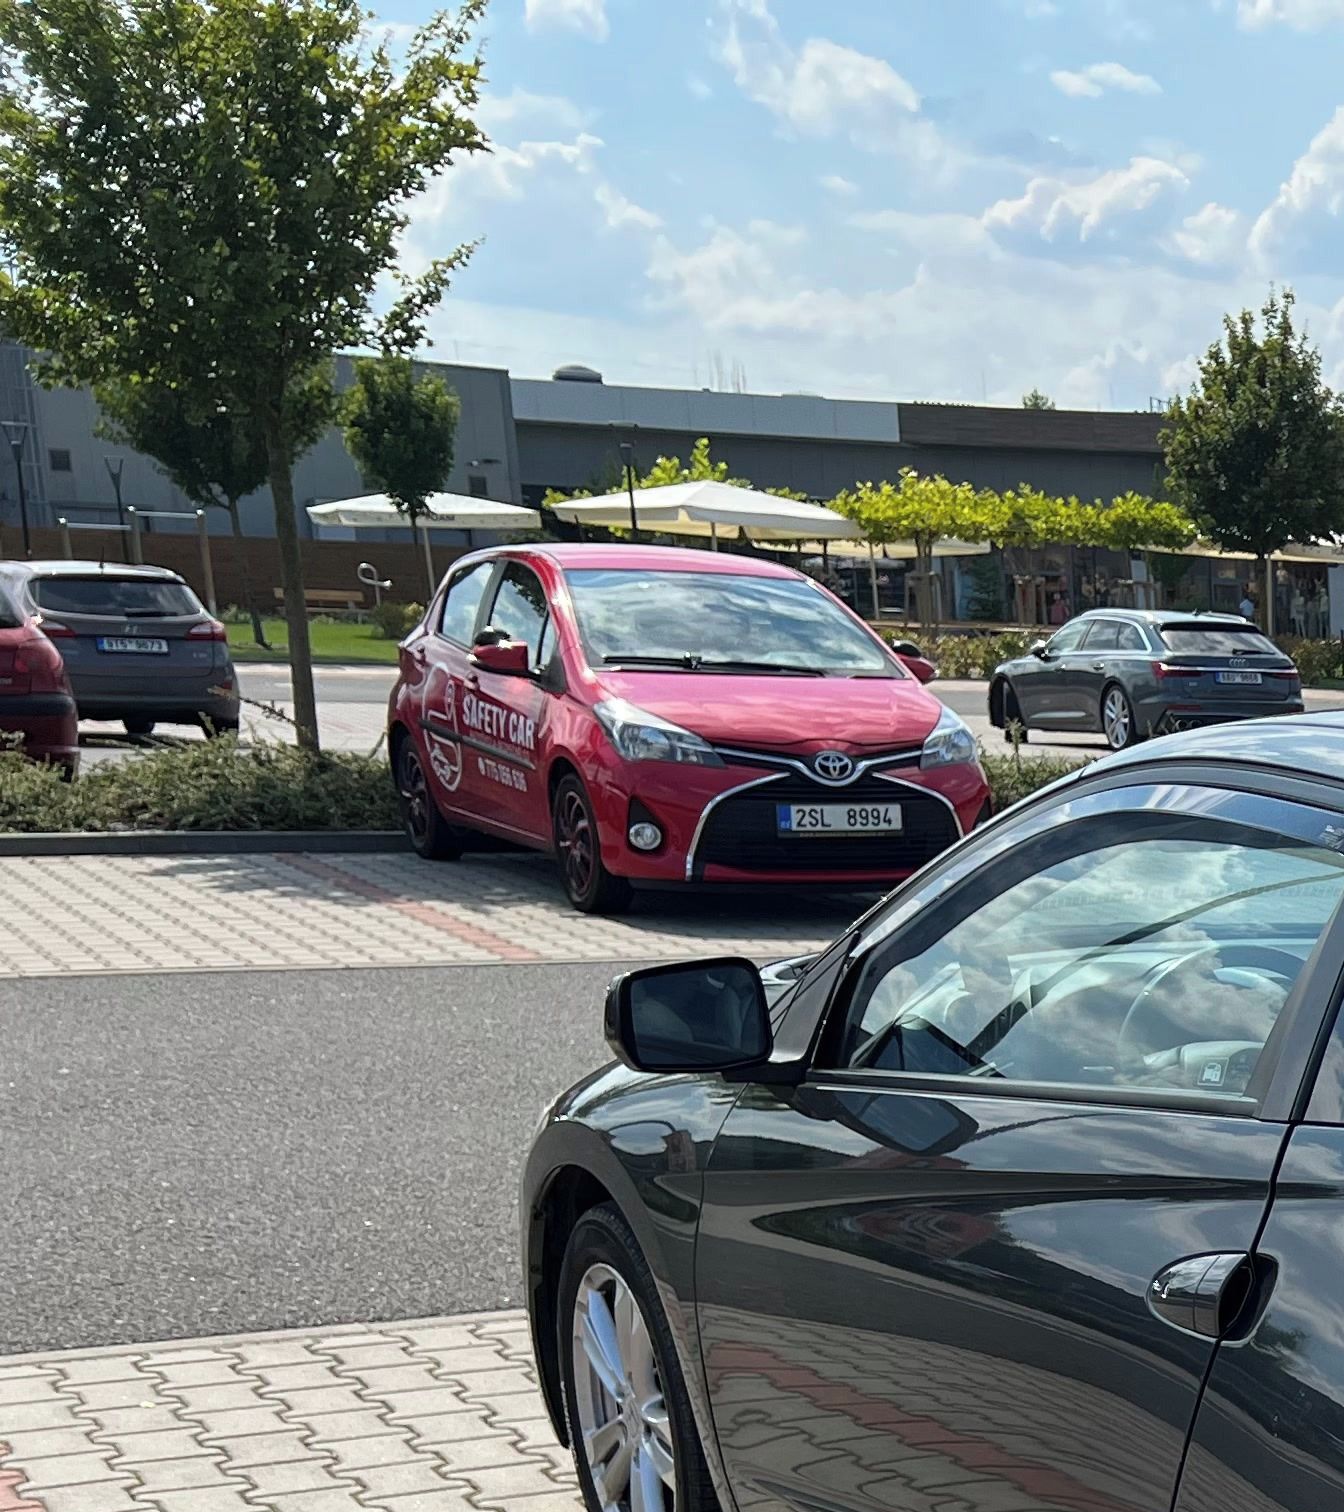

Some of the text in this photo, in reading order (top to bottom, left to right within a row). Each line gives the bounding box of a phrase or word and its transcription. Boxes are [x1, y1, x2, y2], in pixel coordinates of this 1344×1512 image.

[463, 693, 508, 738] SAFETY
[509, 711, 535, 750] CAR
[796, 807, 893, 828] 2SL 8994
